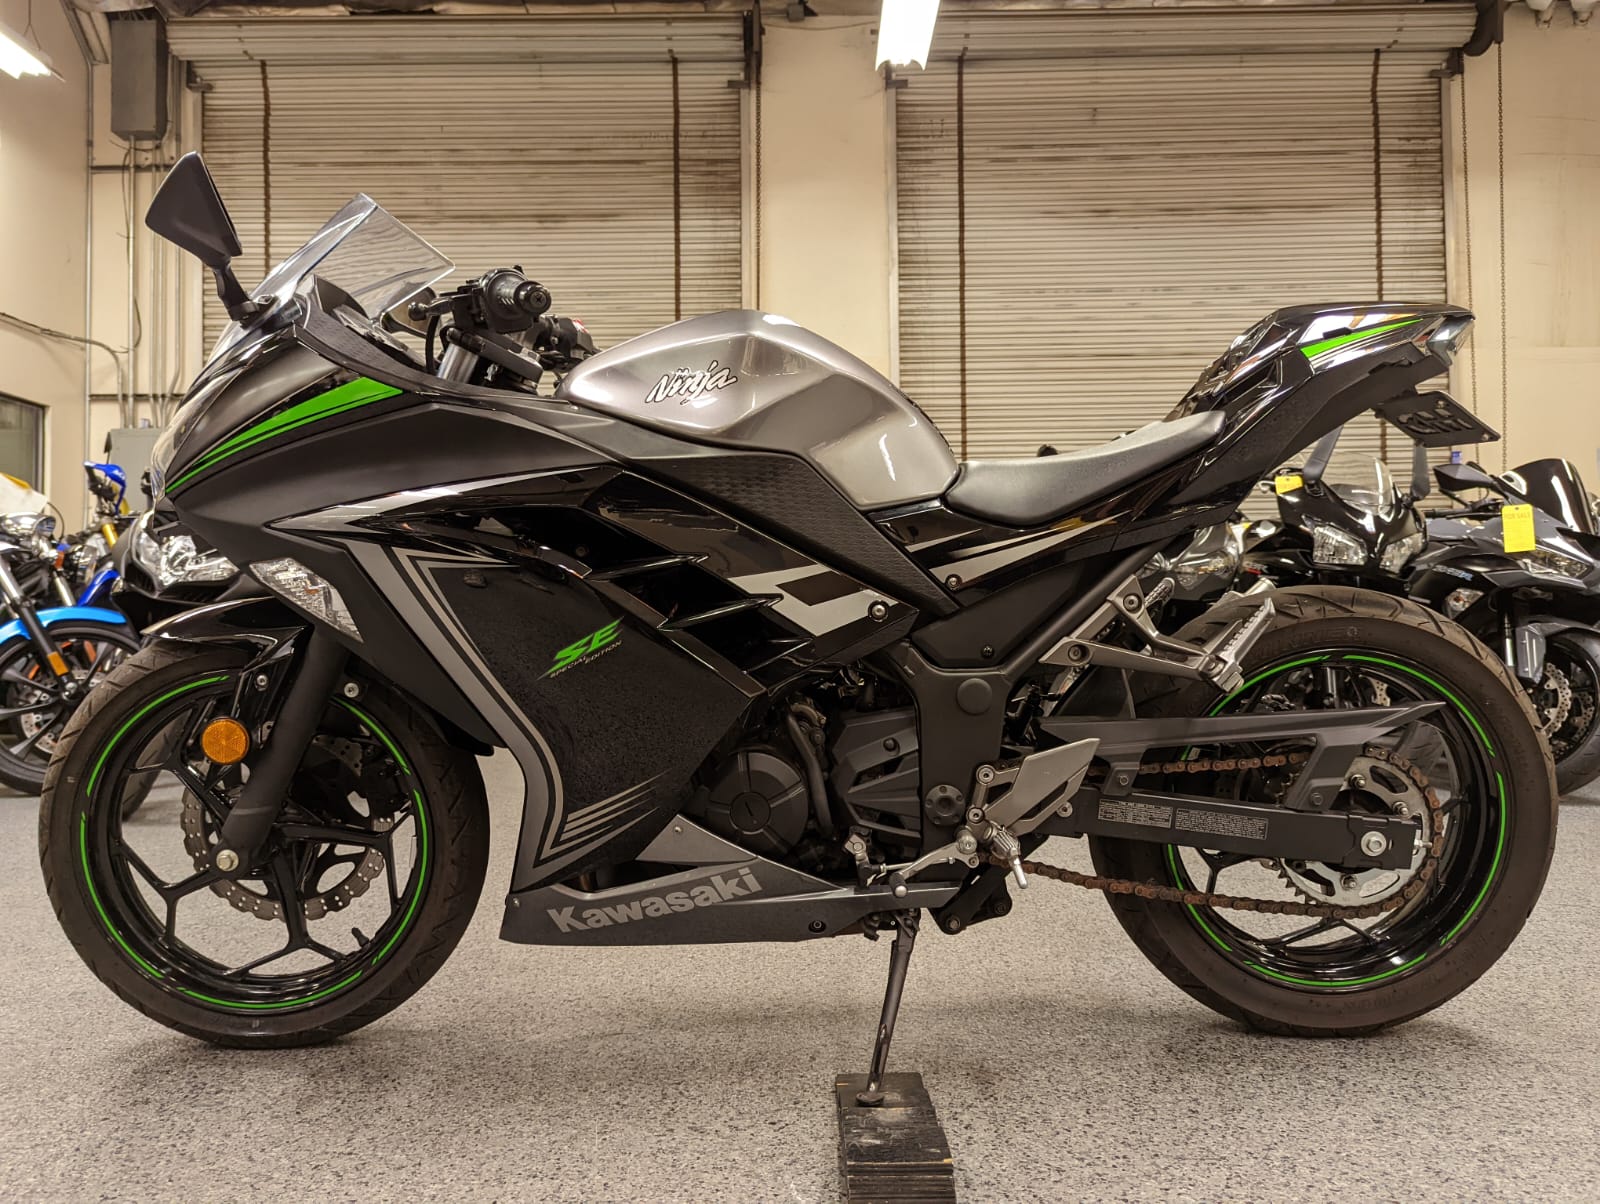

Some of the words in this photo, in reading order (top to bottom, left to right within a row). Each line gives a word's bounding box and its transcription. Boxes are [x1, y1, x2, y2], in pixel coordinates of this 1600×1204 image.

[644, 359, 738, 406] Ninja
[537, 616, 624, 680] SE
[583, 639, 622, 665] EDITION
[547, 867, 763, 933] Kawasaki
